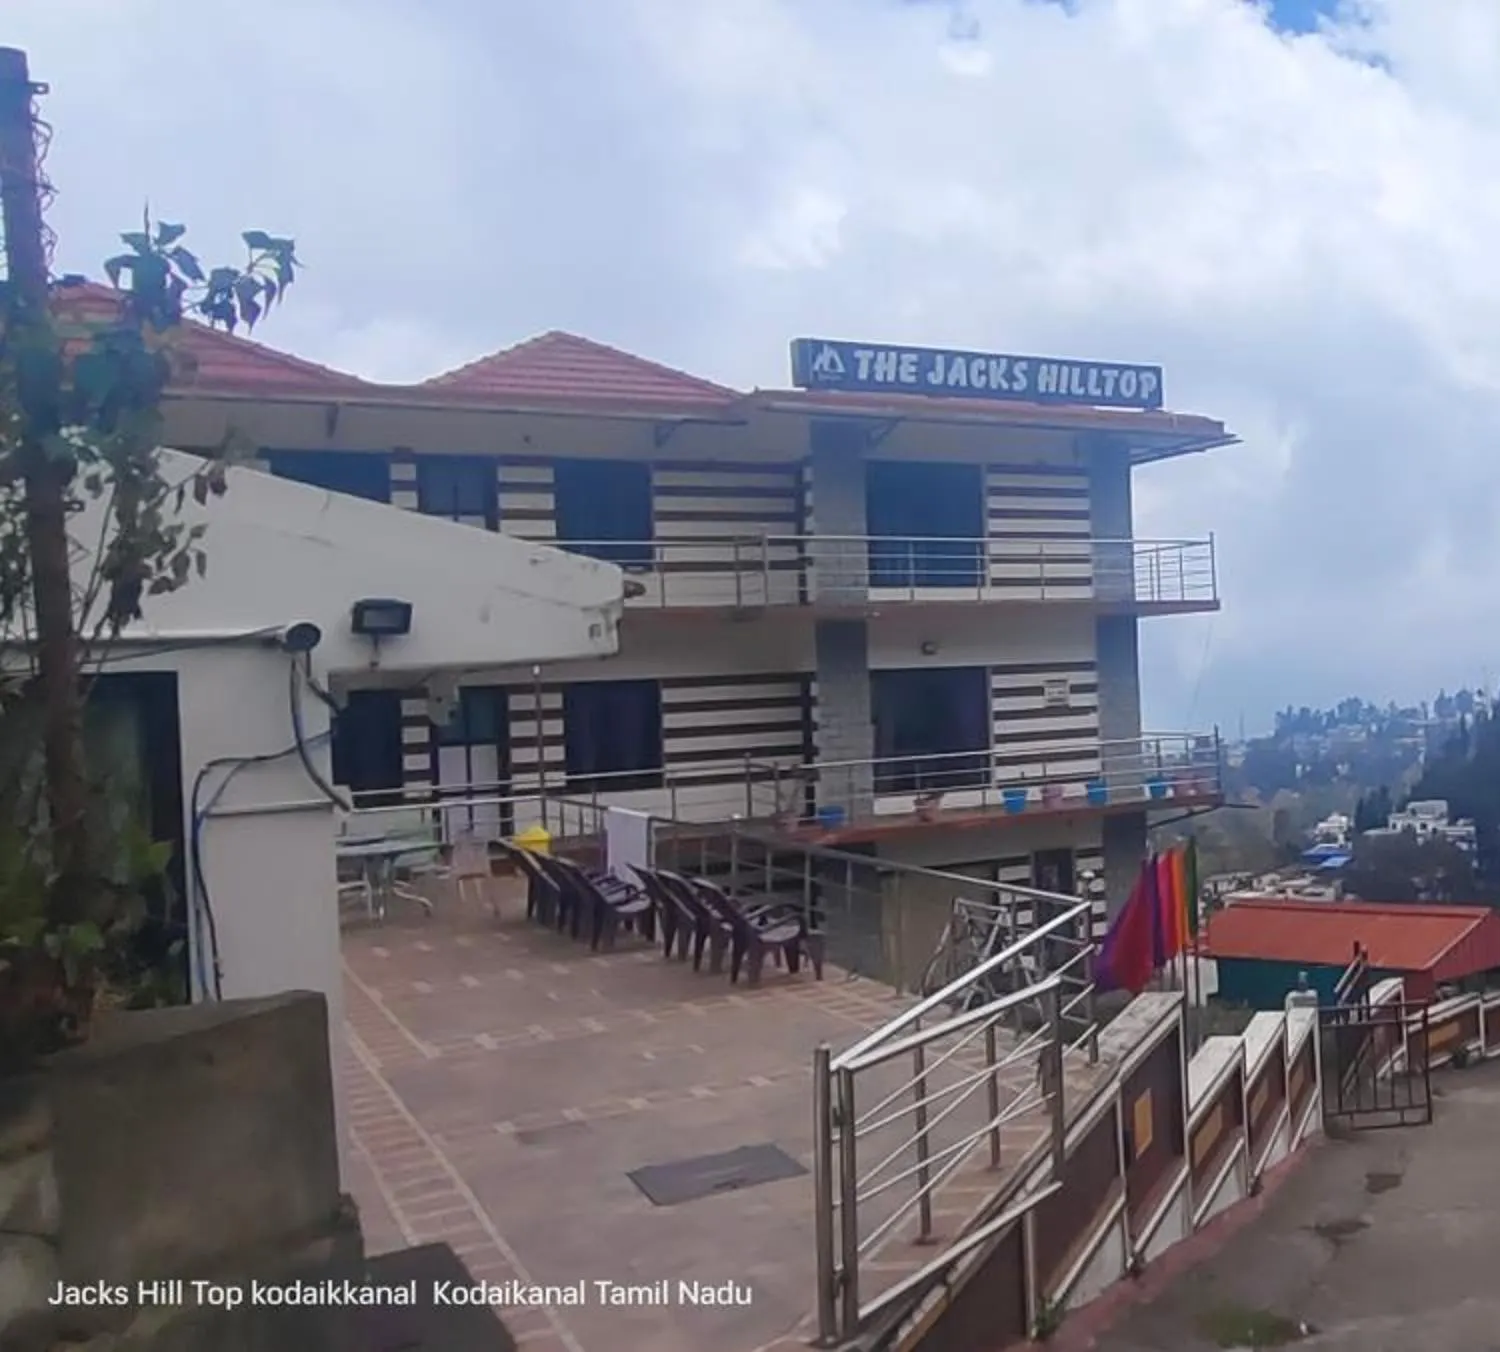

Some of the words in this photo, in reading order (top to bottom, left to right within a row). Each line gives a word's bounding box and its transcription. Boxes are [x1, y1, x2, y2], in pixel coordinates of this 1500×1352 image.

[853, 350, 918, 383] THE
[927, 355, 1027, 391] JACKS
[1037, 364, 1158, 399] HILLTOP
